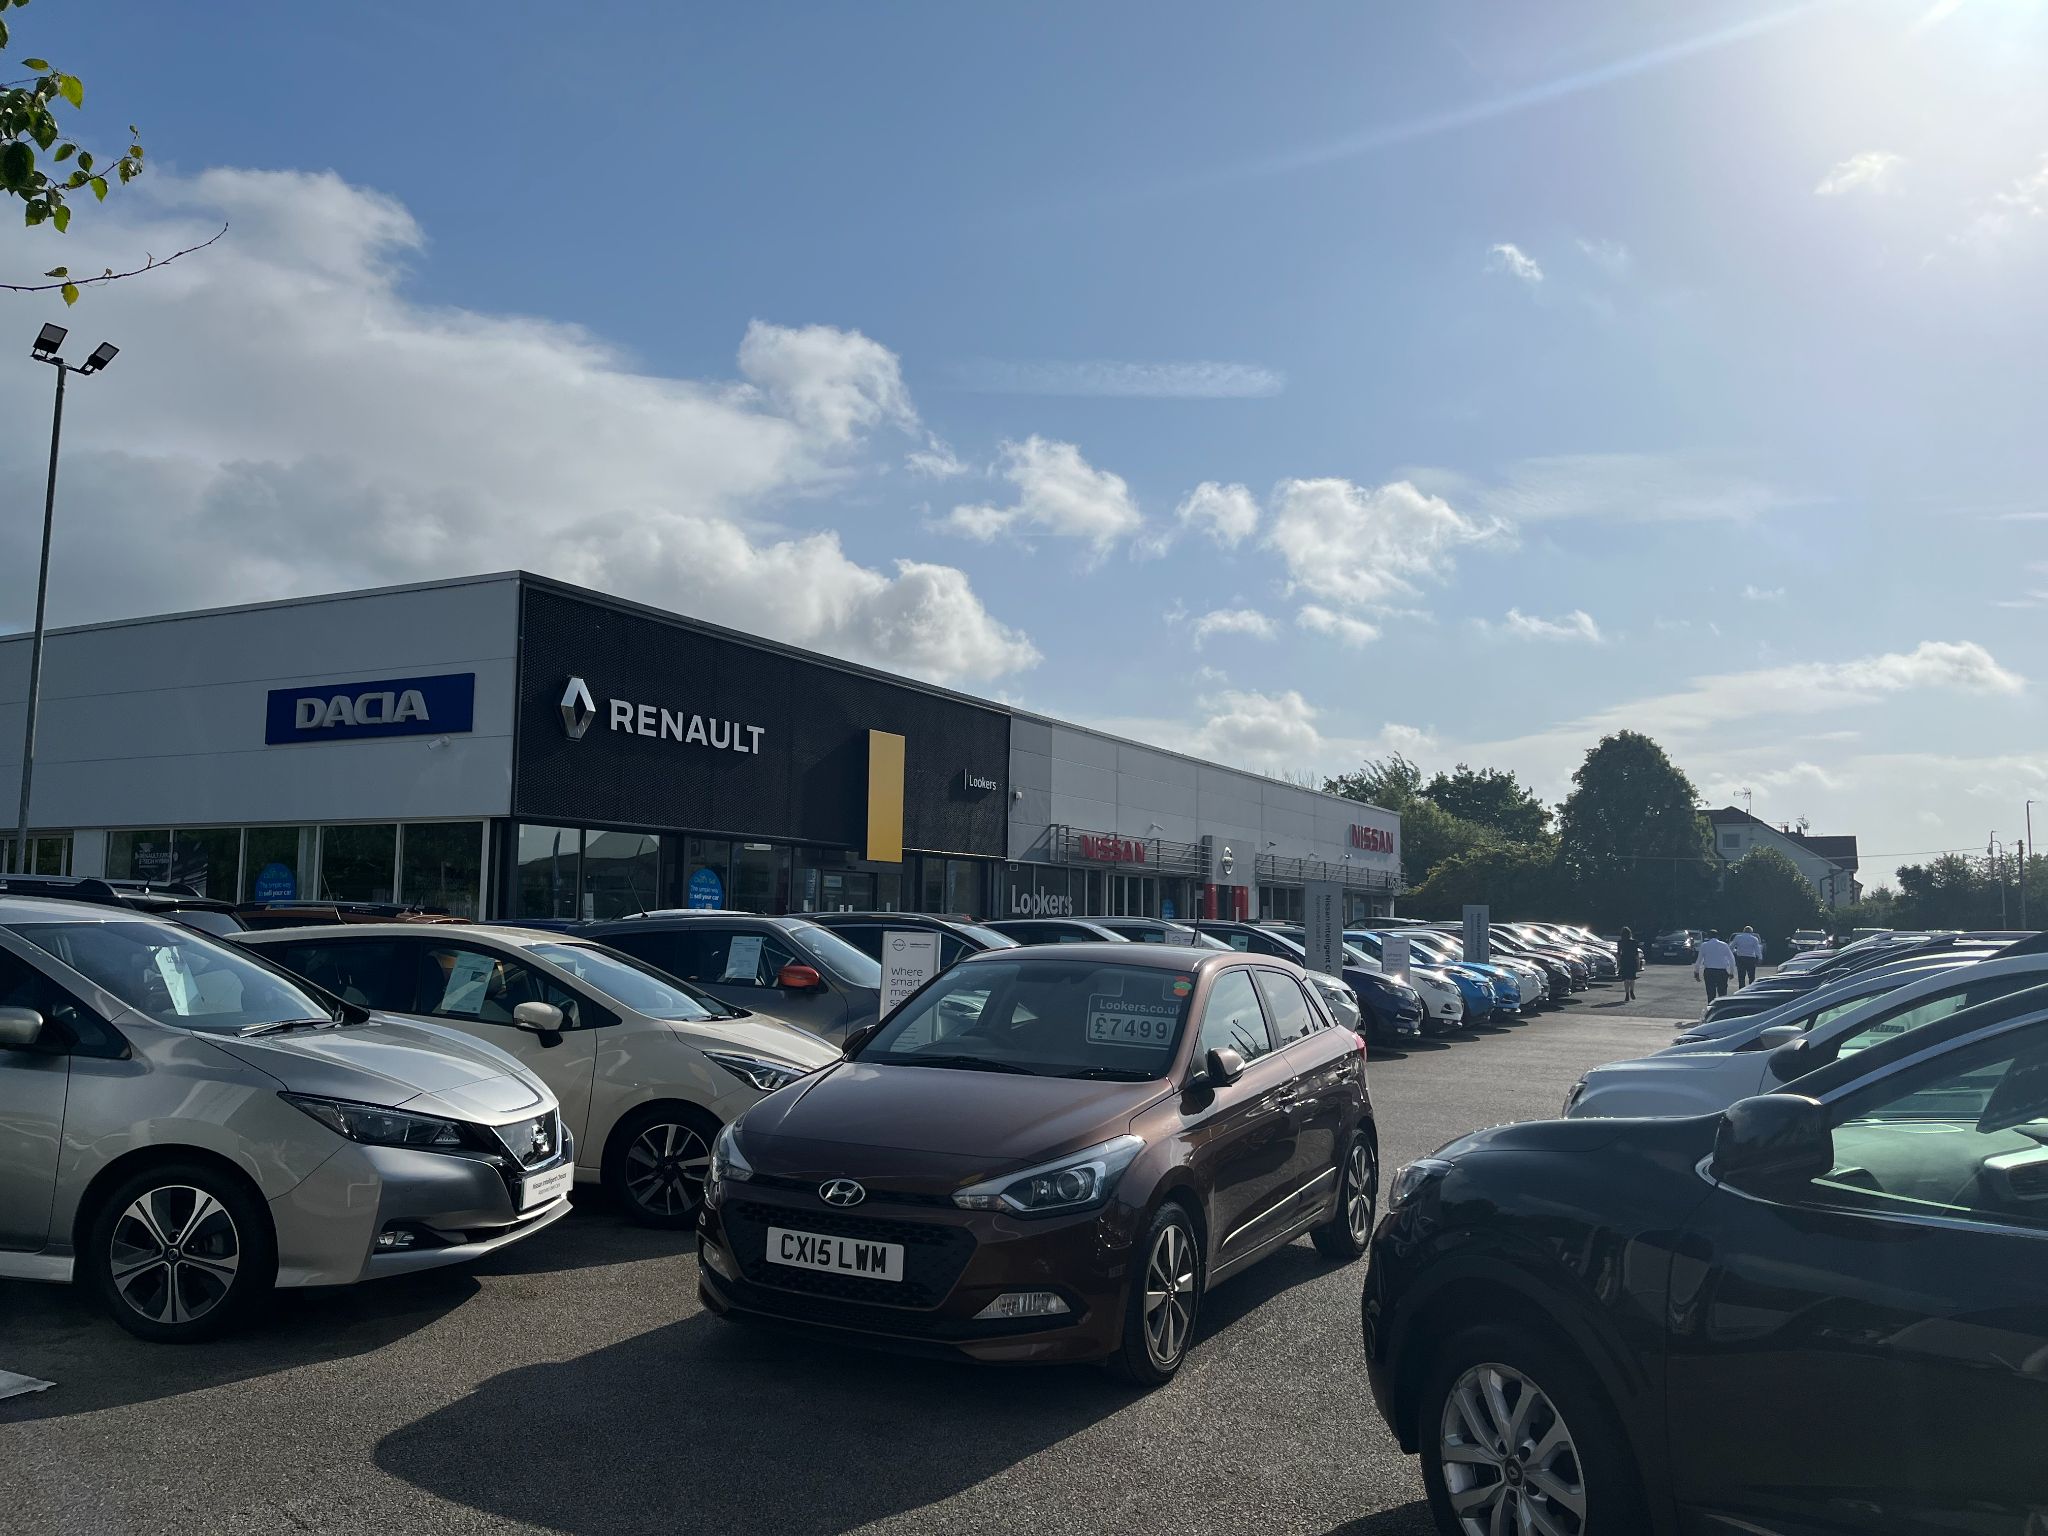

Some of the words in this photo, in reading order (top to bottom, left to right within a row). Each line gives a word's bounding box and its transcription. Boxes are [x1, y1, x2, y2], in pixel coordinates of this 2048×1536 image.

[296, 689, 429, 729] DACIA
[610, 699, 765, 754] RENAULT
[969, 774, 996, 790] Lookers
[1080, 835, 1145, 864] NISSAN
[1351, 823, 1394, 854] NISSAN
[1011, 884, 1073, 915] Lookers
[890, 967, 924, 977] Where
[890, 978, 921, 987] smart
[1094, 1017, 1168, 1039] £7499
[781, 1234, 831, 1265] CX15
[838, 1242, 887, 1273] LWM
